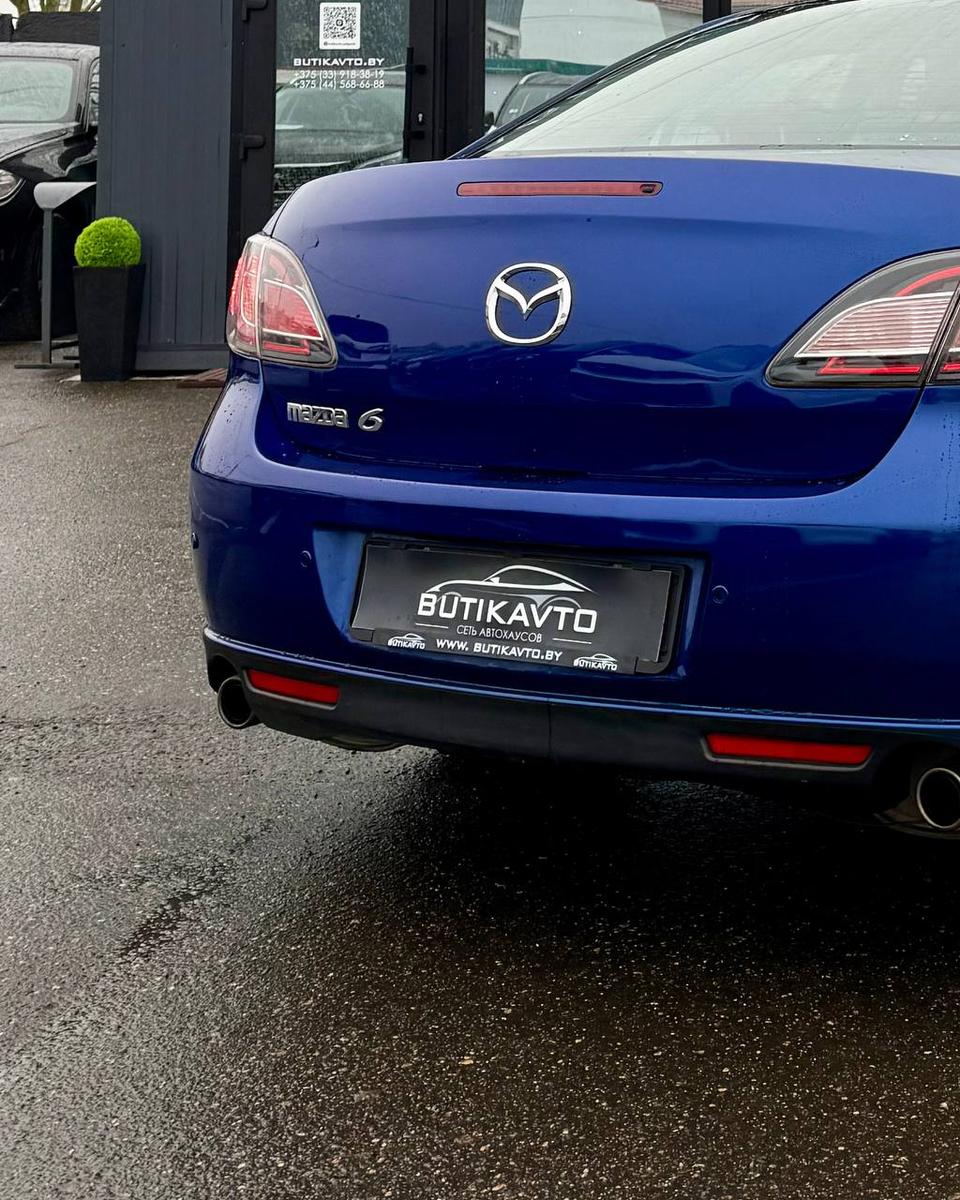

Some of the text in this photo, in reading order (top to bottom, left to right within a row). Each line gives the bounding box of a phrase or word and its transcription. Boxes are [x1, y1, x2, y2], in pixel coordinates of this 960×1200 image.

[293, 58, 385, 66] BUTIKAVTO.BY
[294, 69, 385, 80] +375 (33) 918-38-19
[294, 79, 385, 90] +375 (44) 568-66-88
[358, 407, 384, 431] 6
[417, 593, 598, 634] BUTIKAVTO
[456, 625, 543, 643] СЕТЬ АВТОХАУСОВ
[387, 639, 426, 649] BUTIKAVTO
[436, 638, 563, 662] WWW. BUTIKAVTO.BY
[573, 659, 618, 670] BUTIKAVTO
